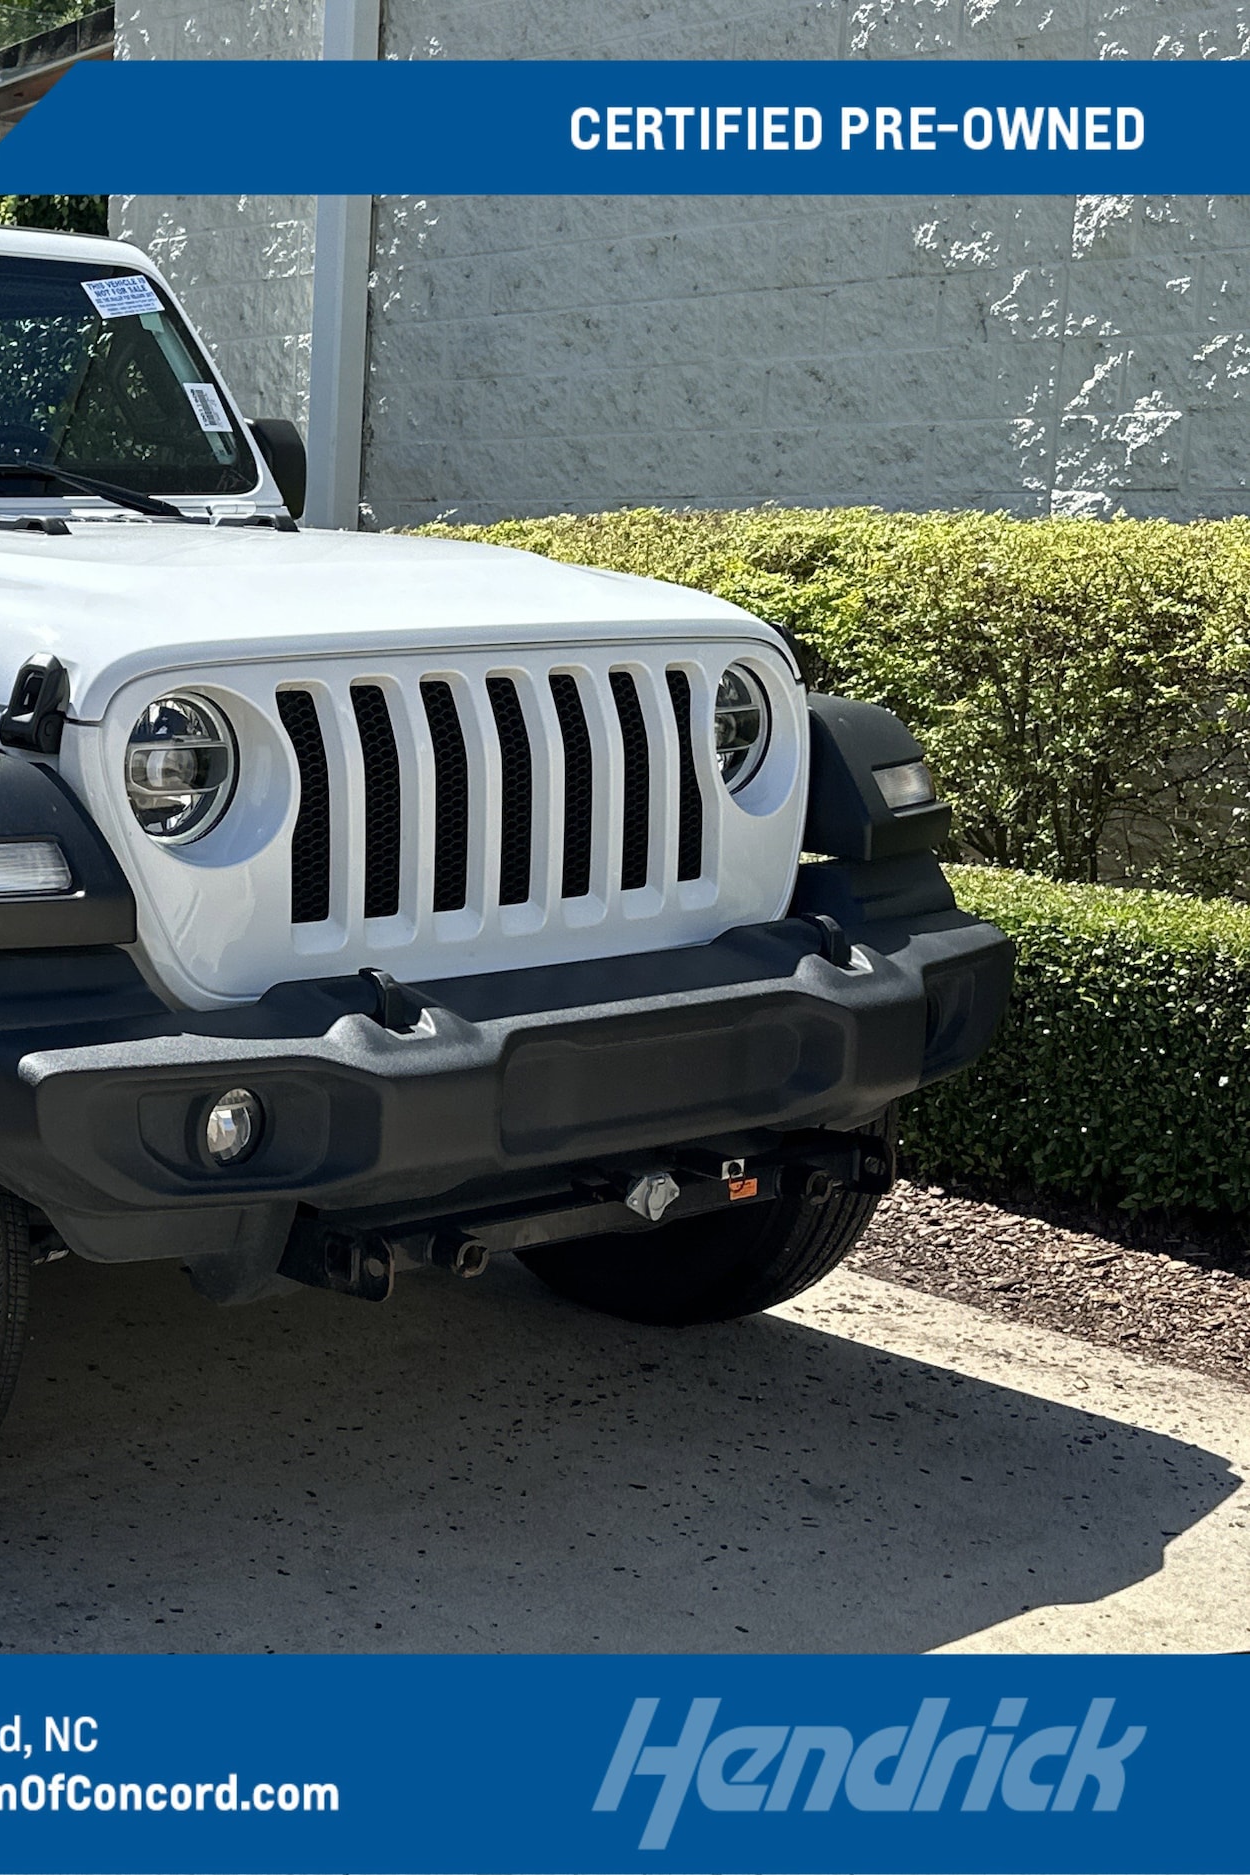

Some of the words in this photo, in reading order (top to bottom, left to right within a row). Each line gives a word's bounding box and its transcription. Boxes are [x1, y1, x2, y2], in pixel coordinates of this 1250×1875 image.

[86, 281, 105, 290] THIS
[105, 277, 137, 288] VEHICLE
[94, 288, 111, 297] NOT
[111, 286, 128, 295] FOR
[128, 284, 147, 293] SALE
